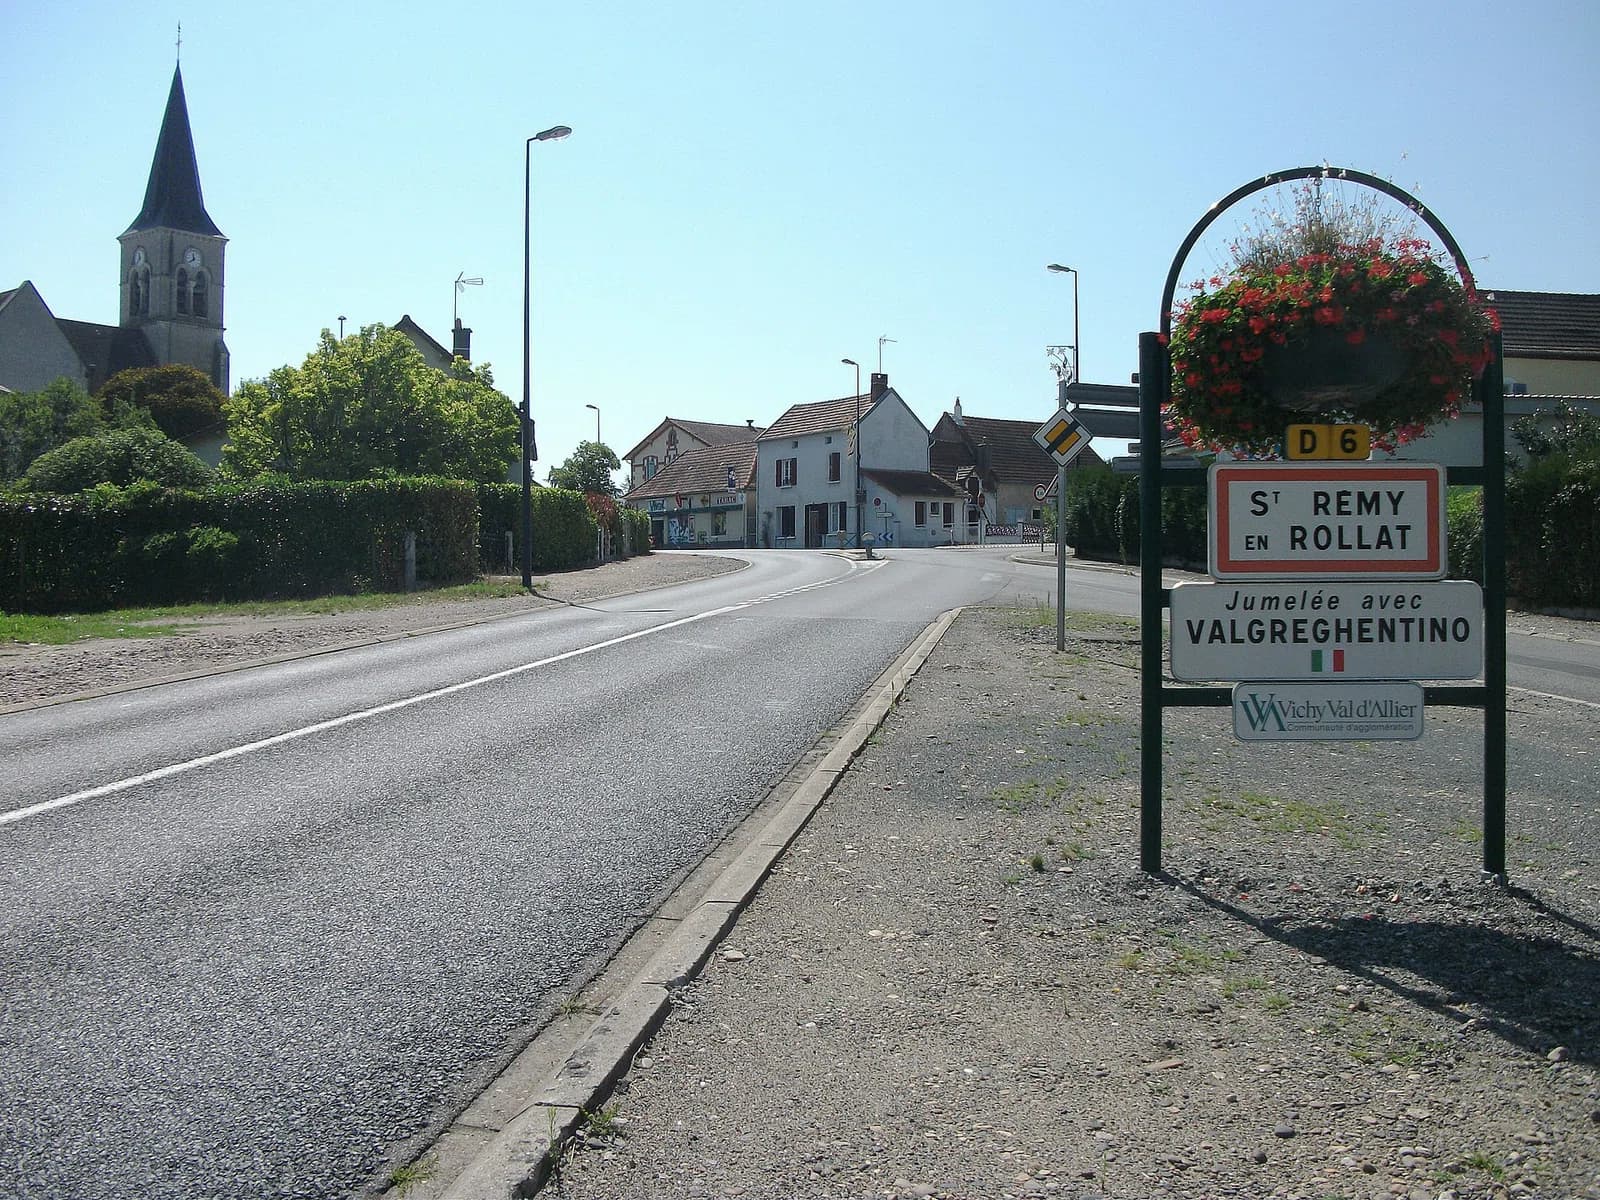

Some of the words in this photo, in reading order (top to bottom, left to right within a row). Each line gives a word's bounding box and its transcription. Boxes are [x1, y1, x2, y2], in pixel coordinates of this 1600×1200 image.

[1300, 430, 1317, 453] D
[1340, 429, 1357, 454] 6
[1245, 535, 1268, 550] EN
[1290, 525, 1411, 550] ROLLAT
[1225, 590, 1340, 611] Jumelée
[1361, 594, 1422, 610] avec
[1186, 617, 1470, 644] VALGREGHENTINO
[1278, 700, 1325, 723] Vichy
[1326, 700, 1353, 719] Val
[1356, 700, 1417, 719] d'Allier
